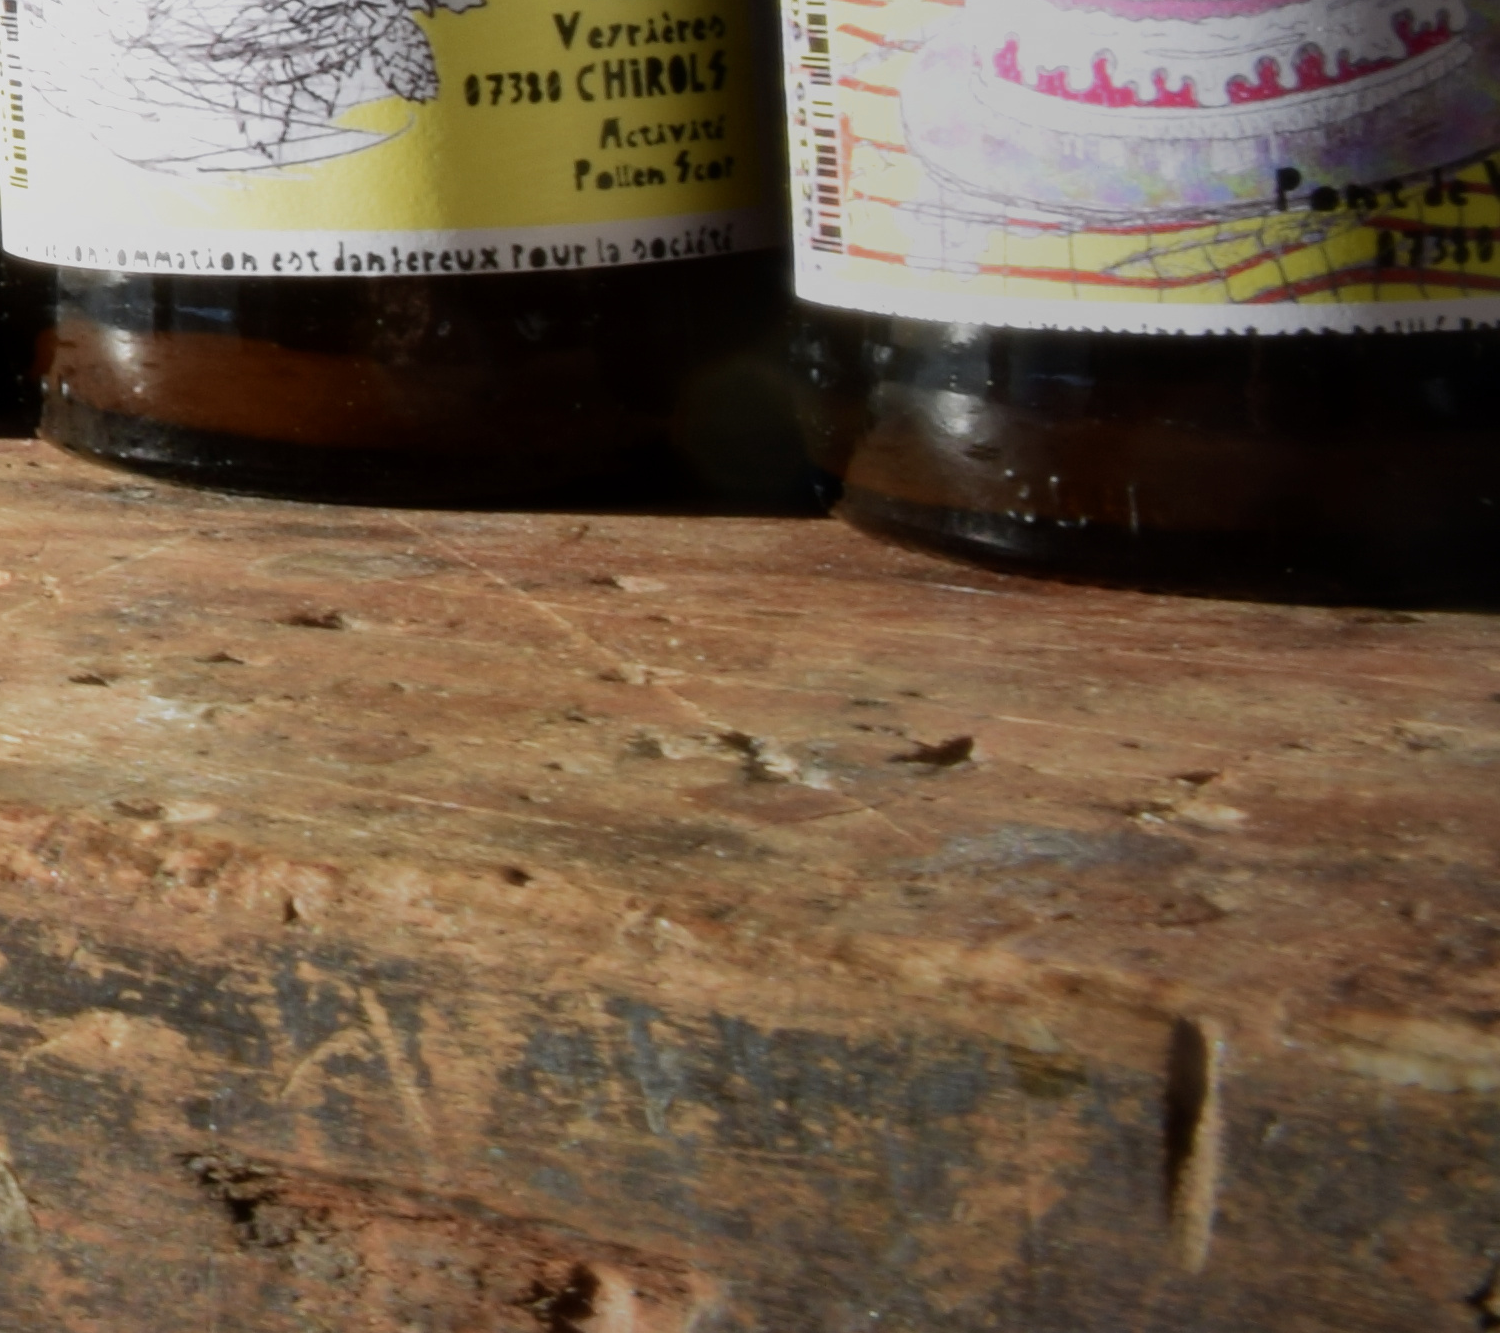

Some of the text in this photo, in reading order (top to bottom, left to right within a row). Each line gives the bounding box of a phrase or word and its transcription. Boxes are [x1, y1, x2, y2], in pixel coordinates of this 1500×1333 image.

[552, 11, 725, 50] Veyrières
[464, 69, 562, 106] 07380
[600, 117, 725, 150] Activité
[1275, 167, 1467, 211] Pont de
[272, 223, 732, 275] est dangereux pour la société
